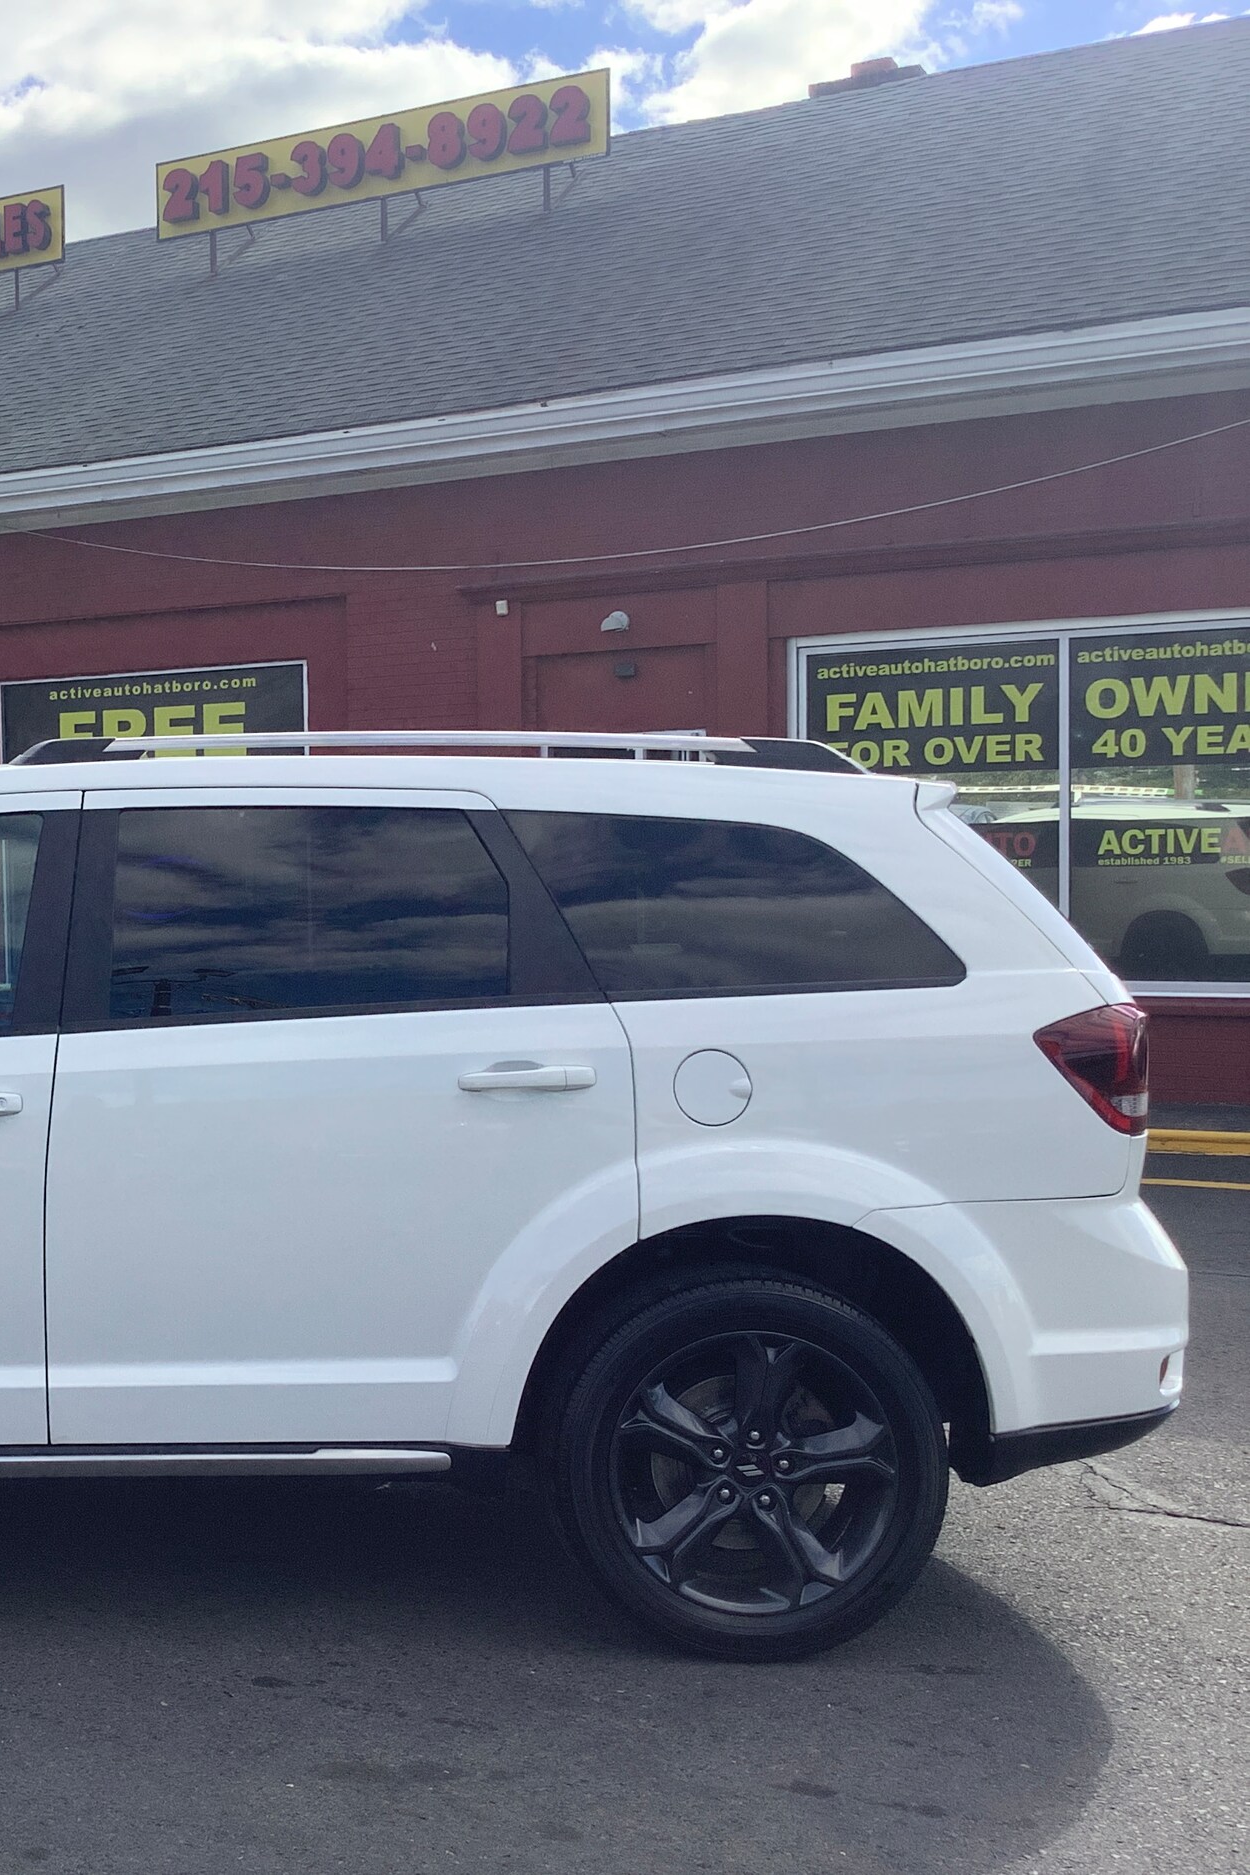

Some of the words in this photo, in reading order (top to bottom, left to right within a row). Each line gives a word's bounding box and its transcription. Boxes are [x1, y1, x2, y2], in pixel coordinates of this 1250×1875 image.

[163, 85, 591, 224] 215-394-8922
[817, 653, 1056, 680] activeautohatboro.com
[1077, 638, 1250, 664] activeautohatb
[48, 675, 257, 701] activeautohatboro.com
[1084, 671, 1250, 719] OWN
[825, 683, 1045, 732] FAMILY
[923, 733, 1045, 766] OVER
[1091, 727, 1147, 759] 40
[1097, 856, 1160, 866] established
[1163, 856, 1191, 865] 1983
